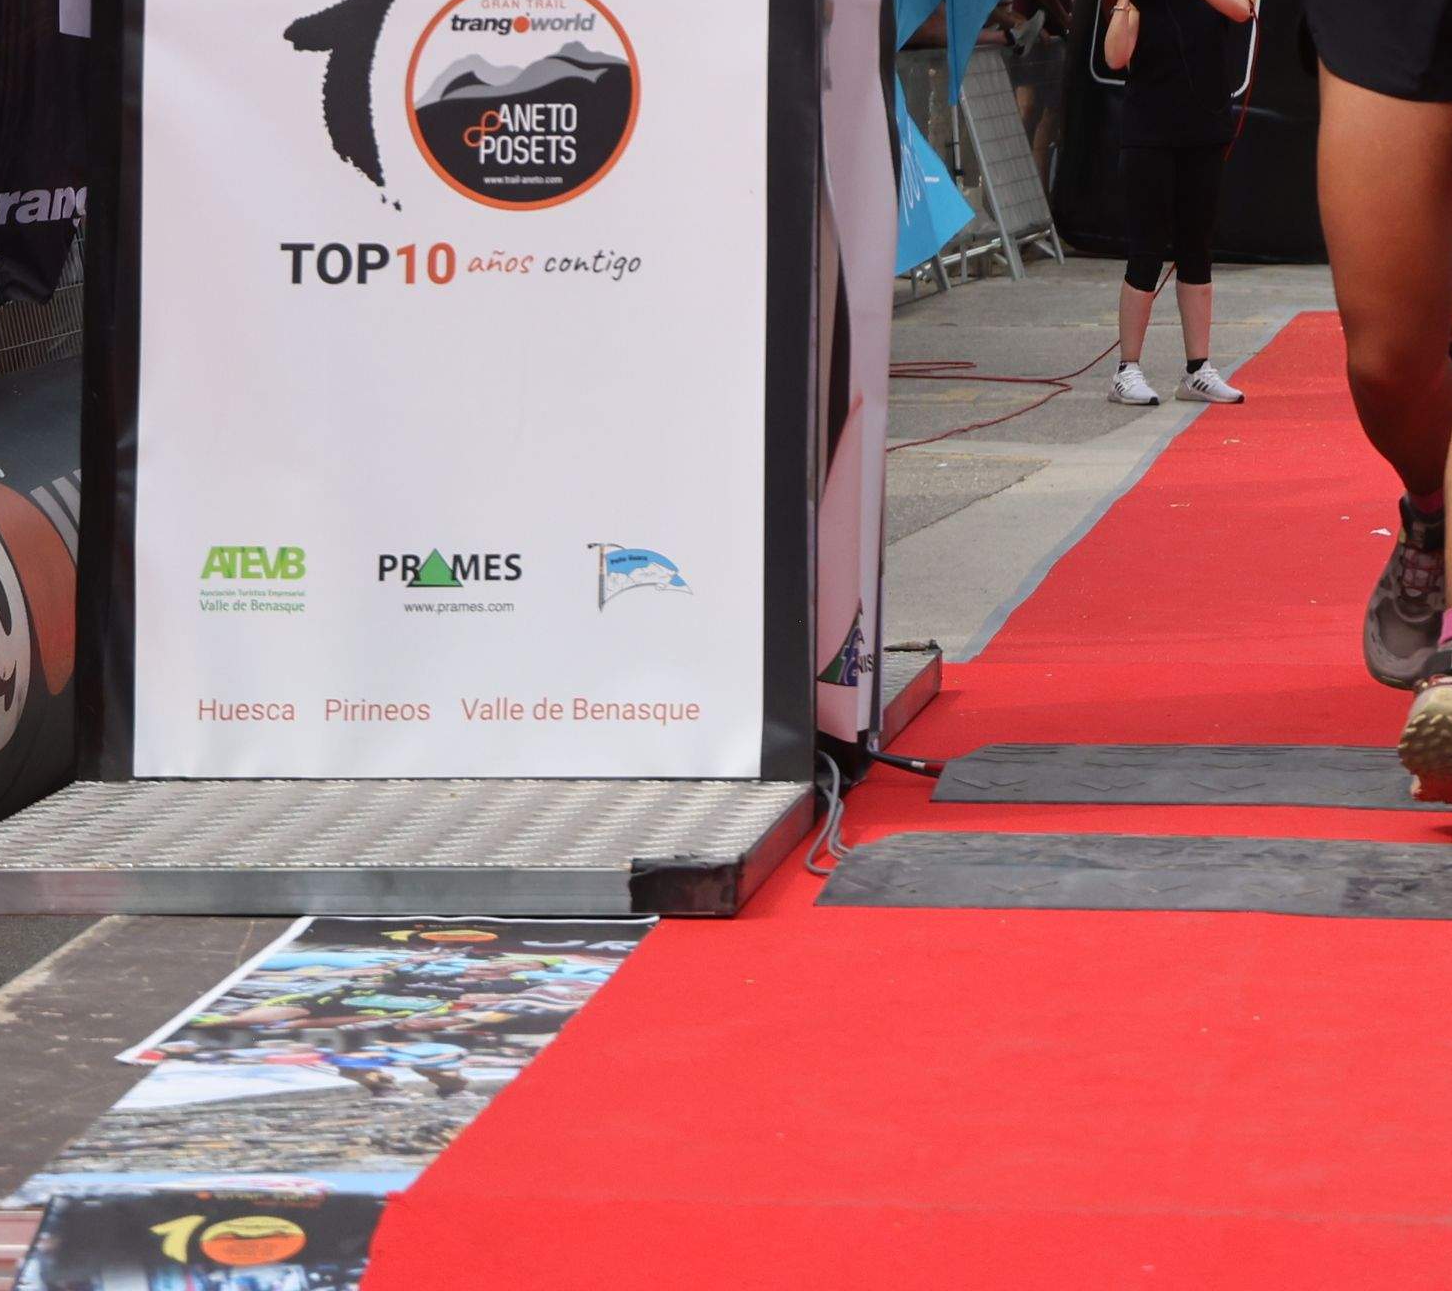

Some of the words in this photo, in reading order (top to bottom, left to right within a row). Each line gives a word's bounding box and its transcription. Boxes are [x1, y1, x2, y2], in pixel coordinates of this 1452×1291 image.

[499, 104, 577, 133] ANETO
[480, 135, 577, 165] POSETS
[467, 250, 533, 274] años
[544, 250, 641, 277] contigo
[200, 546, 306, 580] ATEVB
[200, 599, 228, 612] Valle
[233, 599, 247, 612] de
[250, 599, 305, 615] Benasque
[404, 601, 514, 614] www.prames.com
[198, 699, 295, 721] Huesca
[325, 698, 431, 721] Pirineos
[461, 698, 524, 721] Valle
[532, 698, 564, 721] de
[572, 698, 700, 727] Benasque
